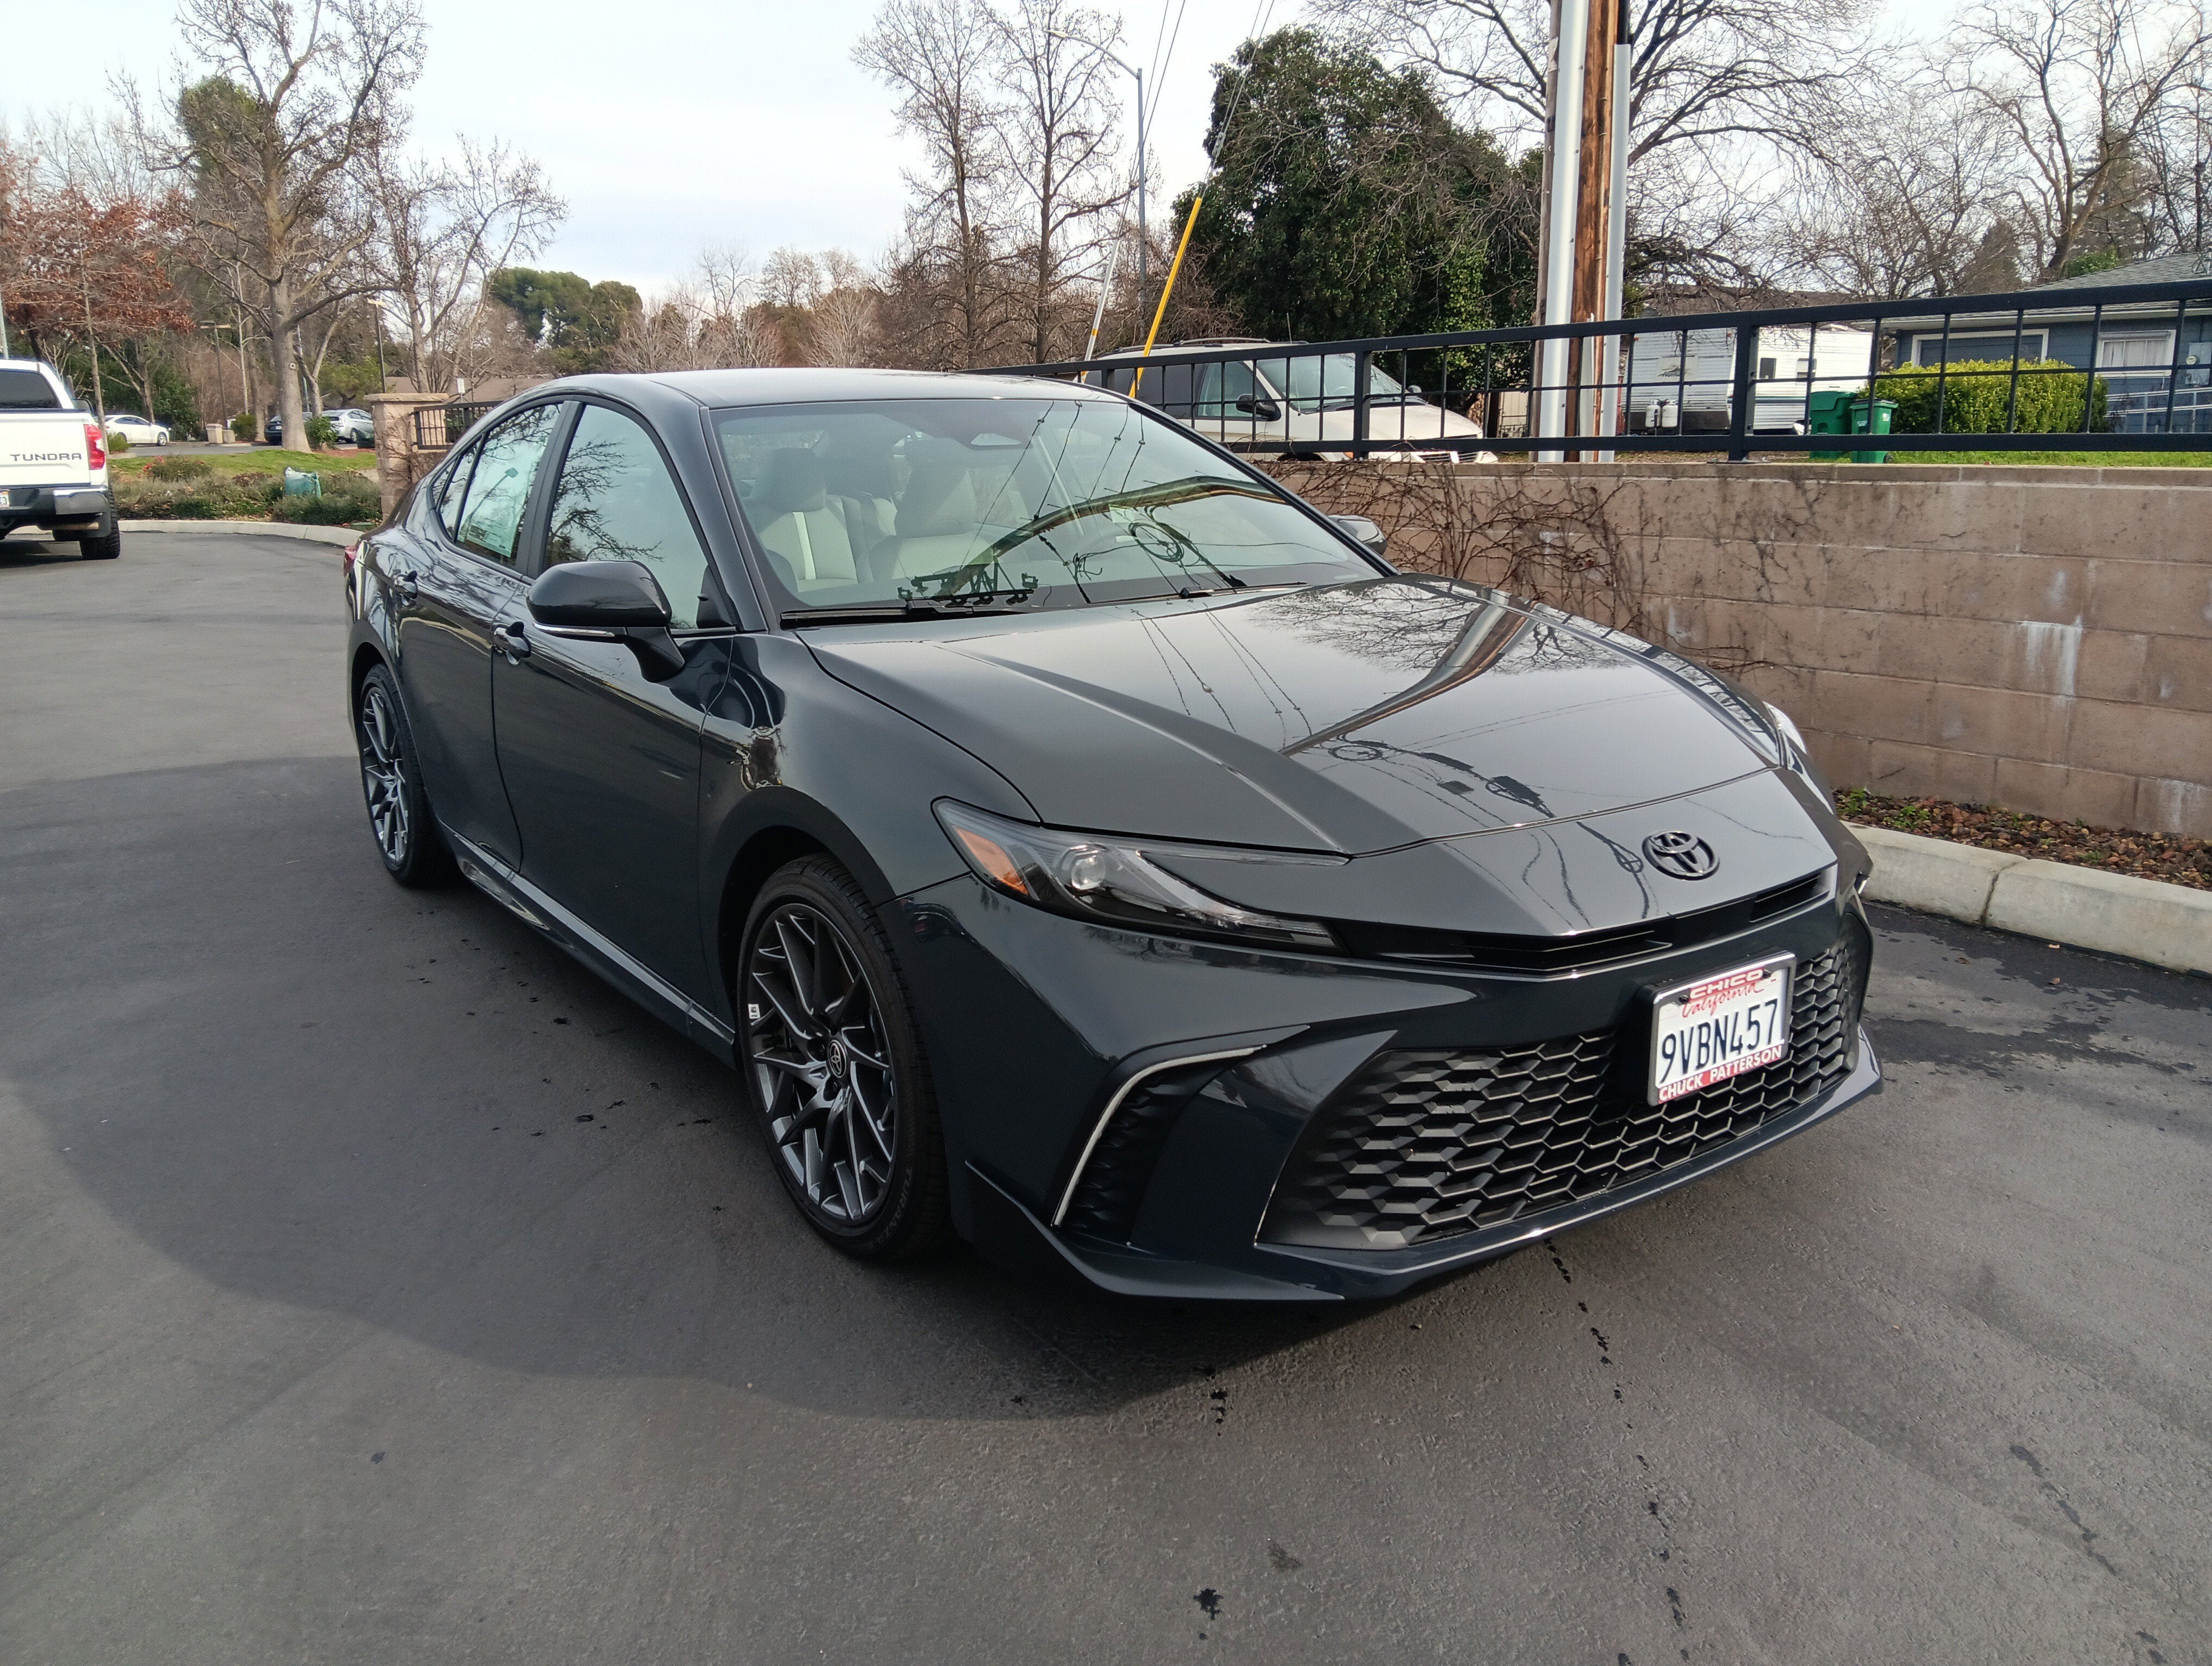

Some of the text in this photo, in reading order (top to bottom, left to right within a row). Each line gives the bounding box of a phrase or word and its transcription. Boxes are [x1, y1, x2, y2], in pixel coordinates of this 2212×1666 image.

[1689, 969, 1763, 999] CHICO
[1660, 998, 1778, 1084] 9VBN457
[1659, 1046, 1782, 1101] CHUCK PATTERSON
